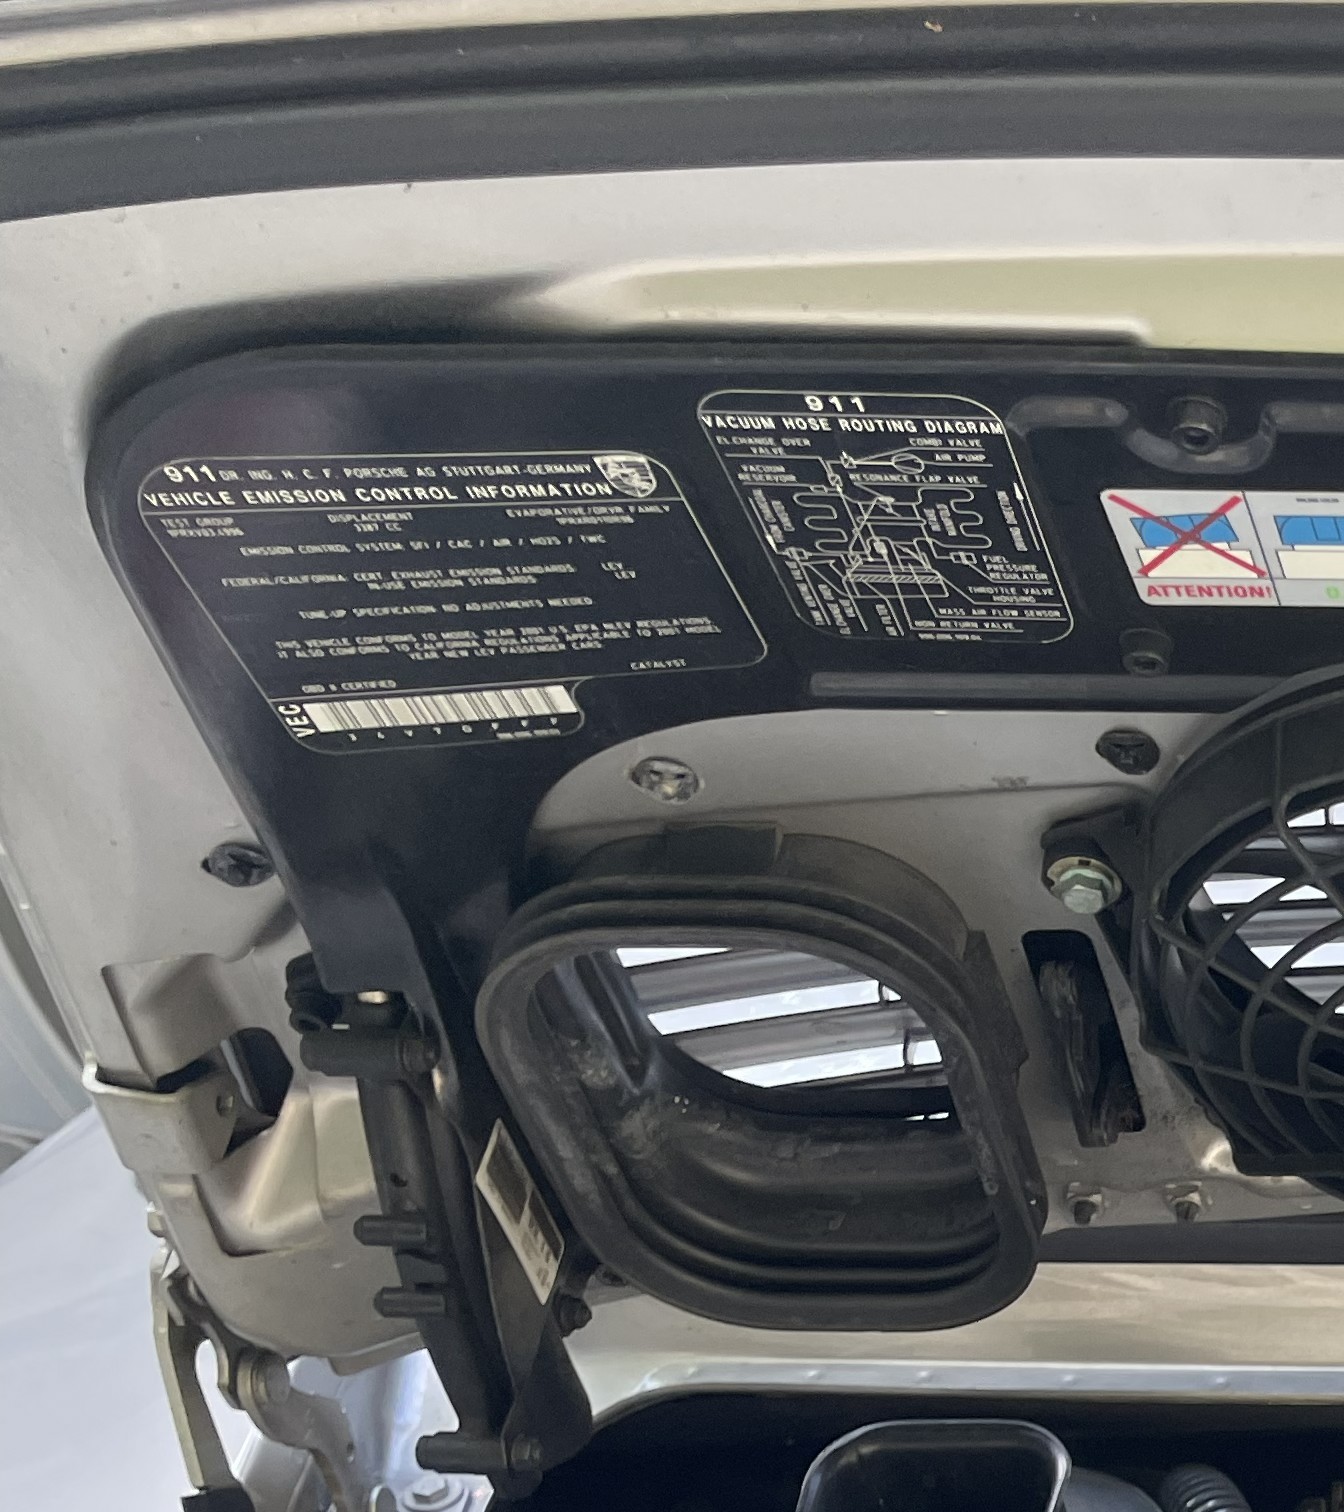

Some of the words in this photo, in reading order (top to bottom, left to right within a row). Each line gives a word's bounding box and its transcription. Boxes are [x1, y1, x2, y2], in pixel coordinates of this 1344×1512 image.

[803, 394, 865, 413] 911
[701, 415, 776, 430] VACUUM
[781, 416, 832, 431] HOSE
[838, 418, 918, 433] ROUTING
[924, 420, 1004, 435] DIAGRAM
[947, 438, 983, 448] VALVE
[935, 453, 952, 462] AIR
[956, 453, 987, 463] PUMP
[163, 464, 217, 483] 911
[343, 466, 409, 480] PORSCHE
[416, 466, 435, 478] AG
[947, 475, 981, 485] VALVE
[143, 490, 236, 508] VEHICLE
[241, 488, 347, 505] EMISSION
[355, 486, 459, 503] CONTROL
[465, 482, 614, 500] INFORMATION
[239, 545, 294, 557] EMISSION
[298, 543, 351, 555] CONTROL
[1147, 584, 1272, 600] ATTENTION!
[629, 658, 687, 671] CATALYST
[278, 704, 316, 739] VEC
